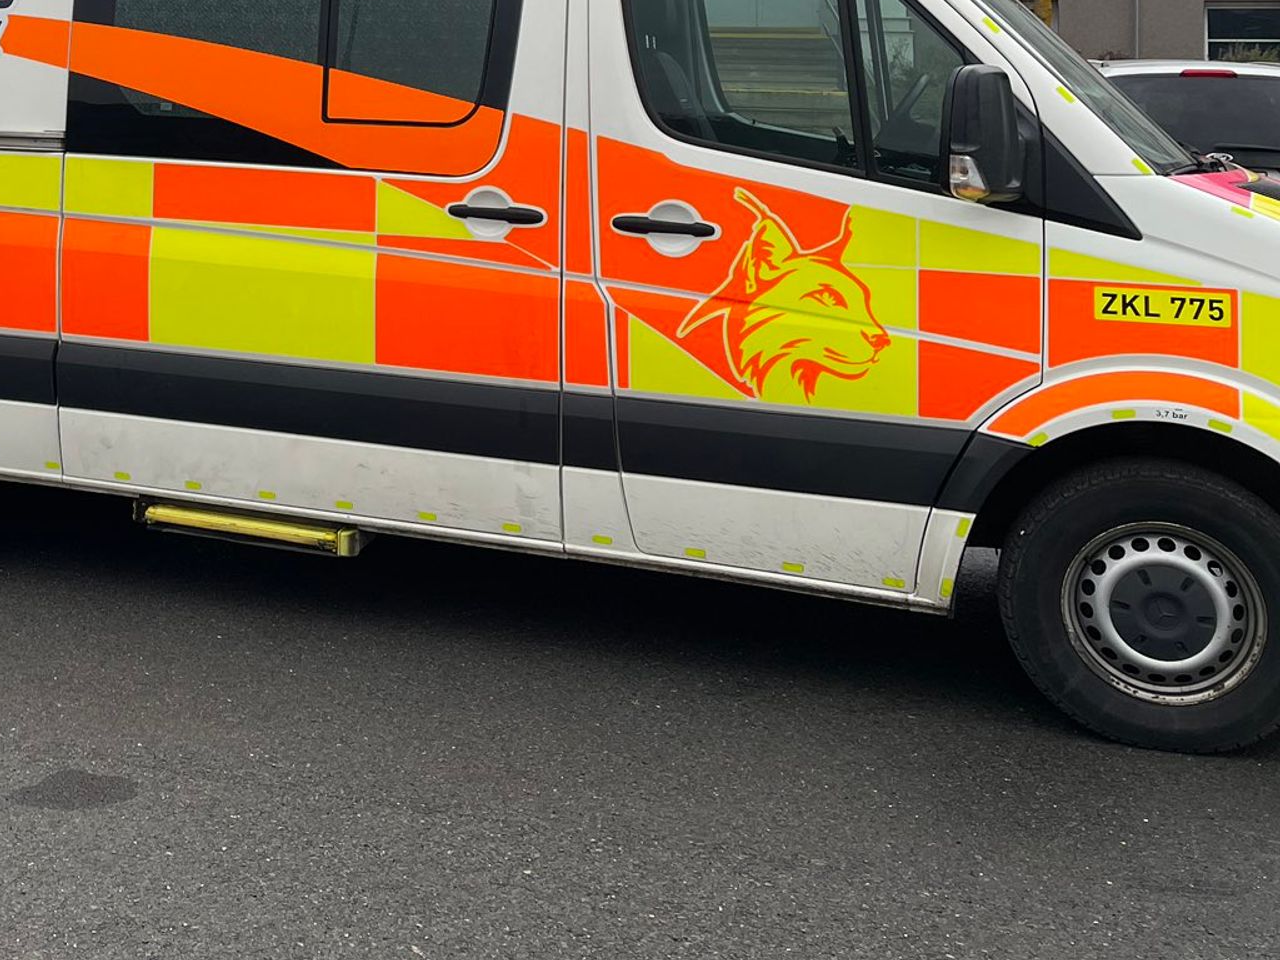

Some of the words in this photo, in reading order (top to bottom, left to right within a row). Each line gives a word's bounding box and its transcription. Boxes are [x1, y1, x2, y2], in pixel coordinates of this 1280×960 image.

[1101, 292, 1161, 318] ZKL
[1170, 297, 1224, 321] 775
[1172, 411, 1188, 420] bar
